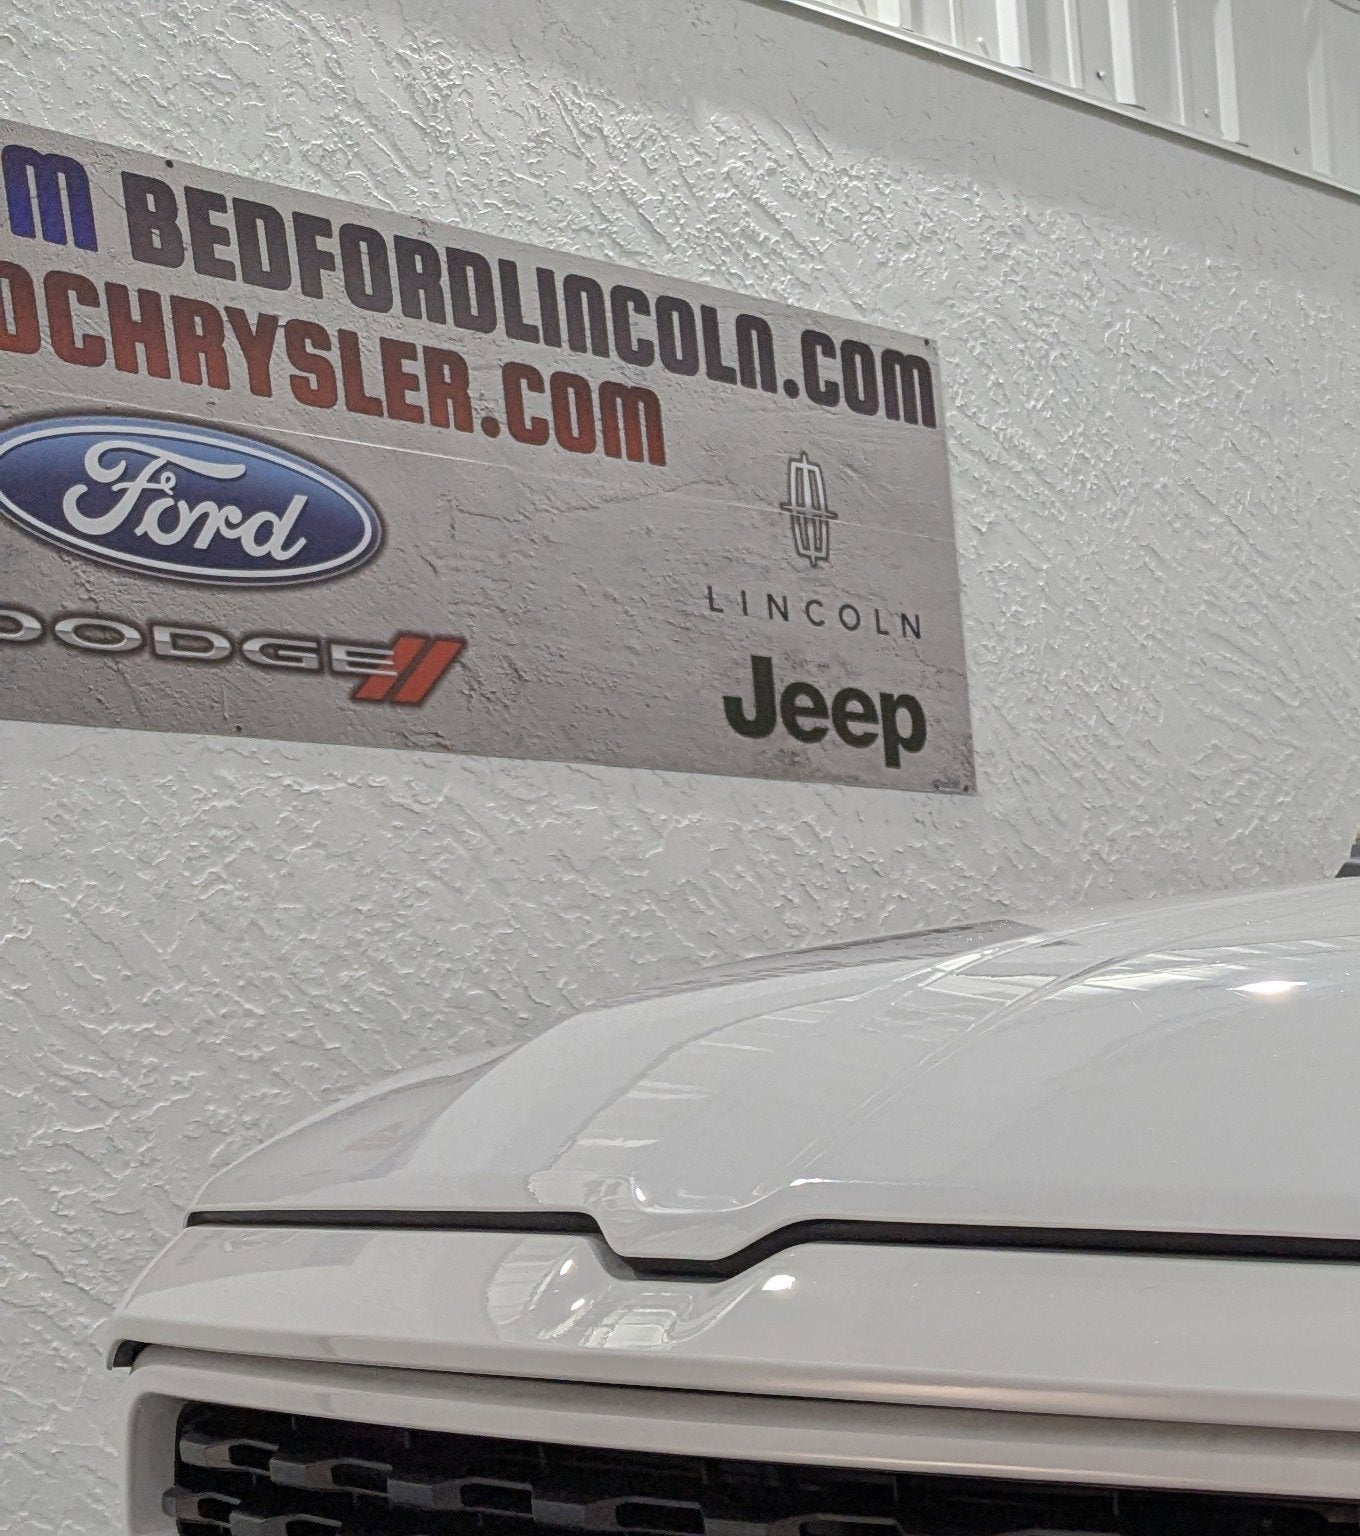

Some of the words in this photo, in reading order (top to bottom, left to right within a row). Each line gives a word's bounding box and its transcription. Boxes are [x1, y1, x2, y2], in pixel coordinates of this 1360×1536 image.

[121, 170, 937, 428] BEDFORDLINCOLN.COM
[62, 440, 306, 567] Ford
[707, 586, 921, 639] LINCOLN
[723, 655, 927, 769] Jeep
